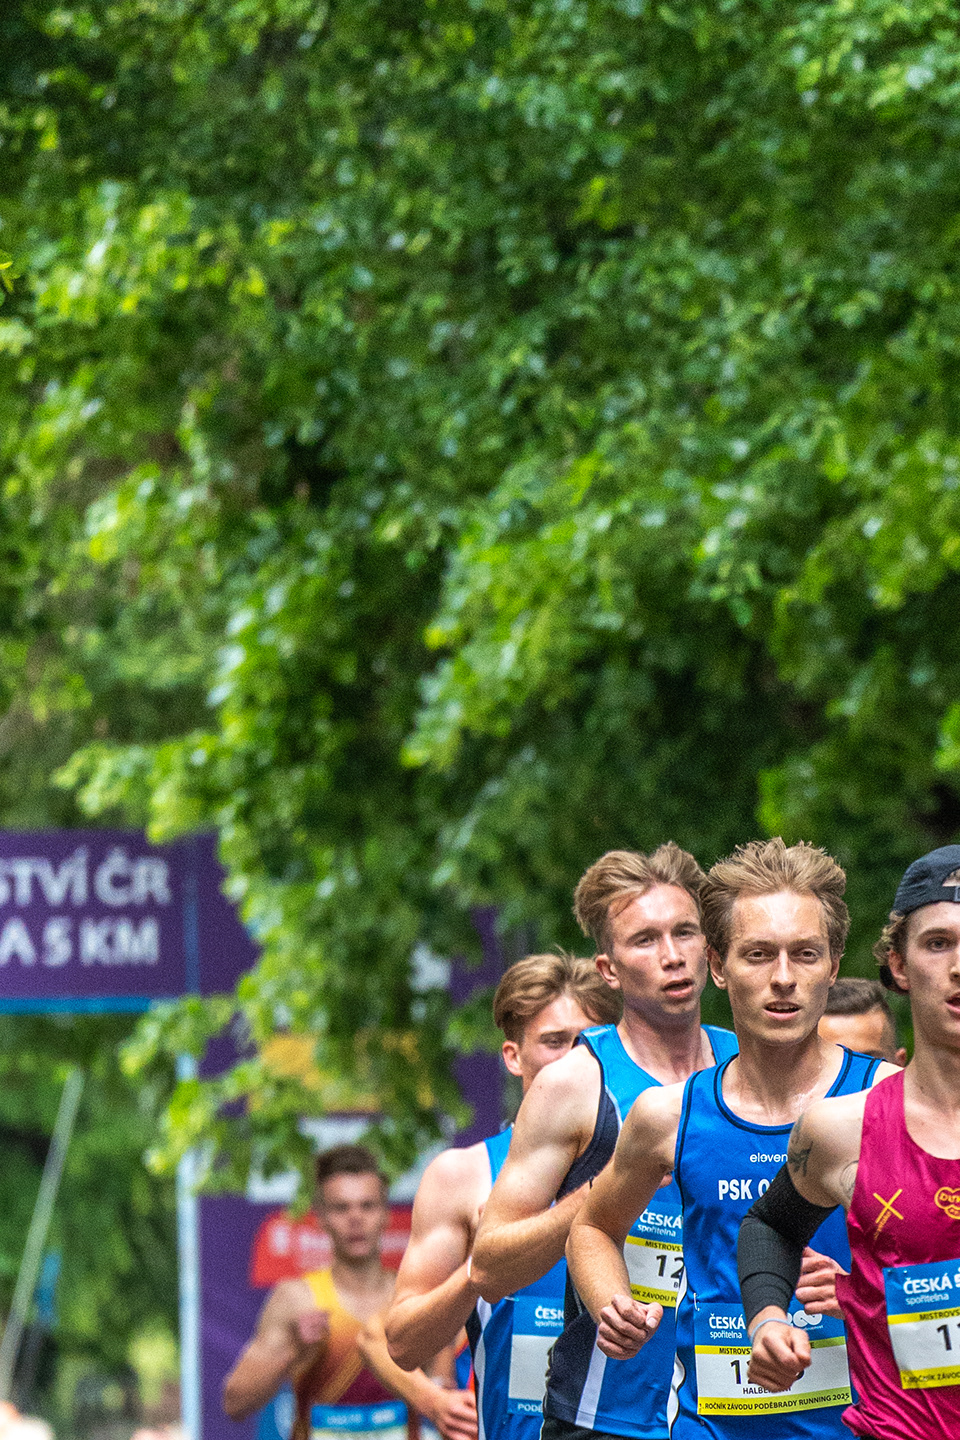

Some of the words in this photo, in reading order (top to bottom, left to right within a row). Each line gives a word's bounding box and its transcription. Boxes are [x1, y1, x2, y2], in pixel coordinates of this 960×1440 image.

[95, 847, 171, 905] ČR
[80, 917, 159, 966] KM
[718, 1179, 753, 1200] PSK
[639, 1209, 682, 1230] ČESKÁ
[645, 1241, 683, 1252] MISTROVS
[903, 1272, 953, 1294] ČESKÁ
[906, 1293, 949, 1306] spořitelna
[709, 1313, 746, 1329] ČESKÁ
[709, 1331, 742, 1339] spořitelna
[719, 1347, 752, 1355] MISTROVS
[705, 1402, 726, 1410] ROČNÍK
[727, 1401, 752, 1410] ZÁVODU
[754, 1400, 797, 1411] PODĚBRADY
[799, 1395, 832, 1406] RUNNING
[832, 1392, 850, 1402] 2025
